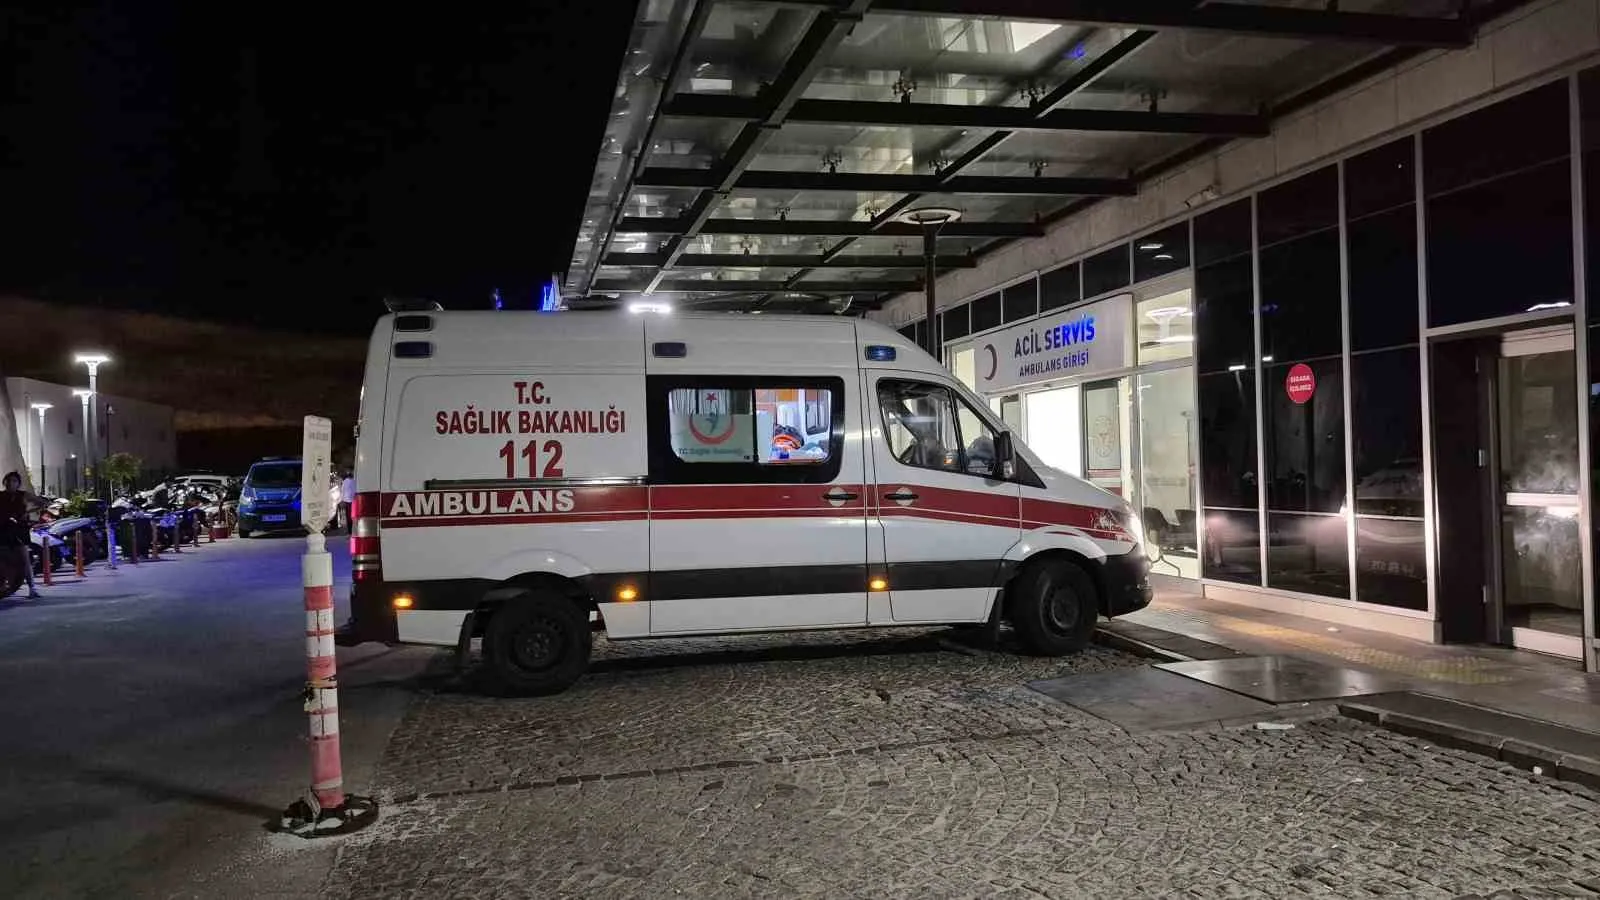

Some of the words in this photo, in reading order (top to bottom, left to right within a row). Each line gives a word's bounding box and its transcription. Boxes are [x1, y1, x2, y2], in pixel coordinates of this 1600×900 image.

[1014, 328, 1042, 359] ACİL
[1044, 314, 1095, 350] SERVİS
[1019, 358, 1061, 377] AMBULANS
[514, 381, 551, 404] T.C.
[436, 404, 512, 434] SAĞLIK
[518, 403, 626, 433] BAKANLIĞI
[499, 440, 564, 478] 112
[389, 489, 575, 516] AMBULANS
